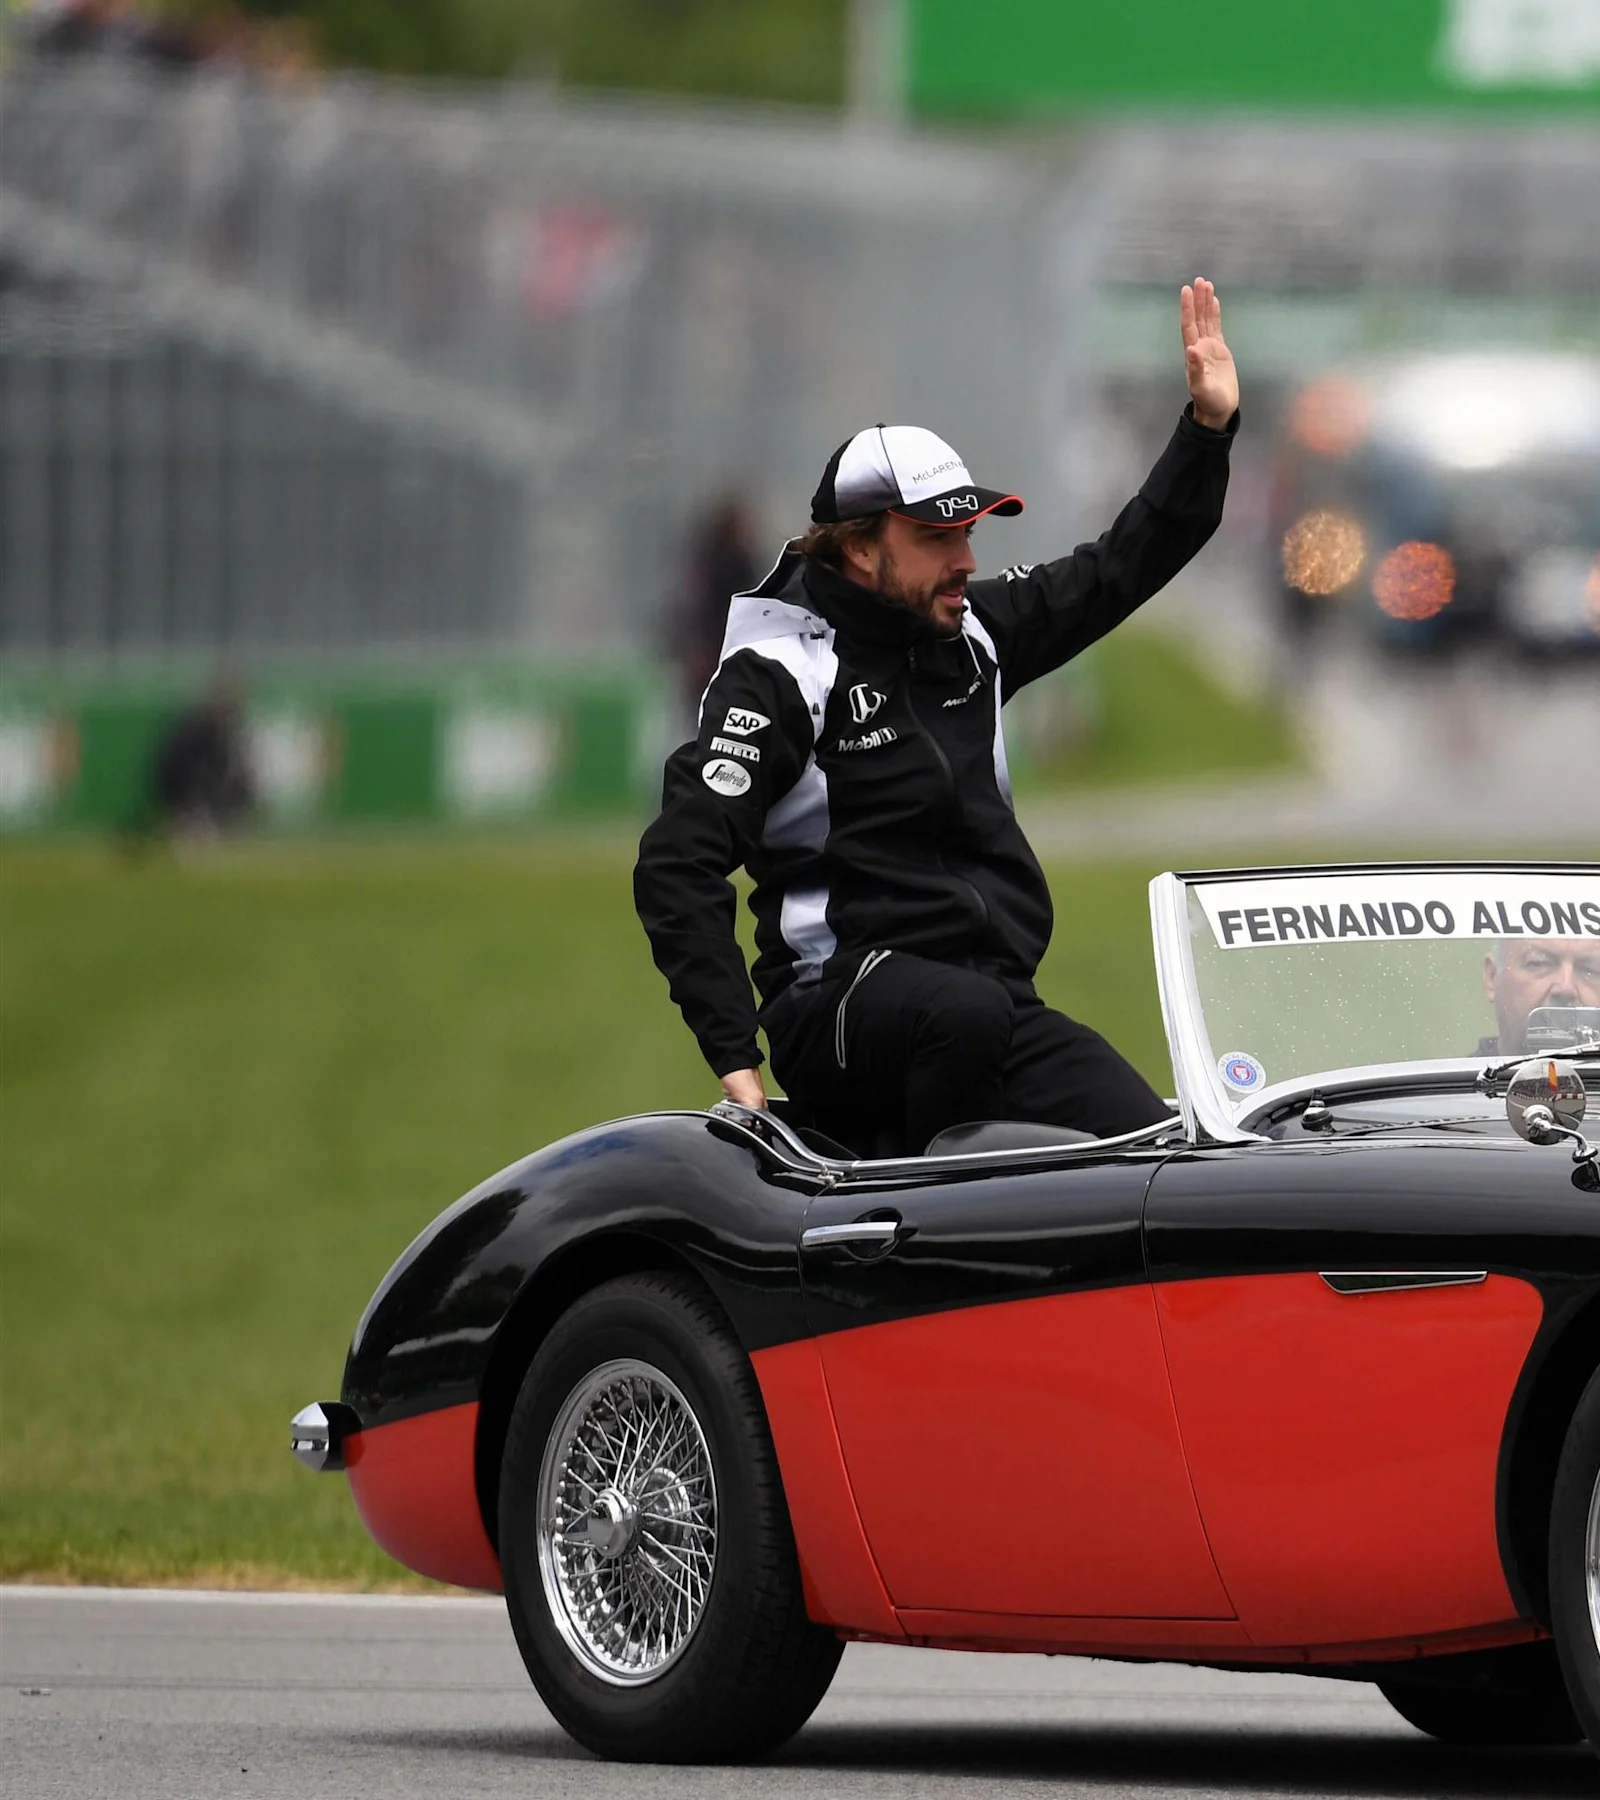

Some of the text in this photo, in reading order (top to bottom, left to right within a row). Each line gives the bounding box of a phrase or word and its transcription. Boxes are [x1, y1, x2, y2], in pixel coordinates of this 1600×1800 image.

[936, 495, 978, 517] 14
[726, 713, 760, 730] SAP
[710, 736, 760, 763] PIRELLI
[706, 764, 747, 788] Segafredo
[1218, 900, 1455, 945] FERNANDO
